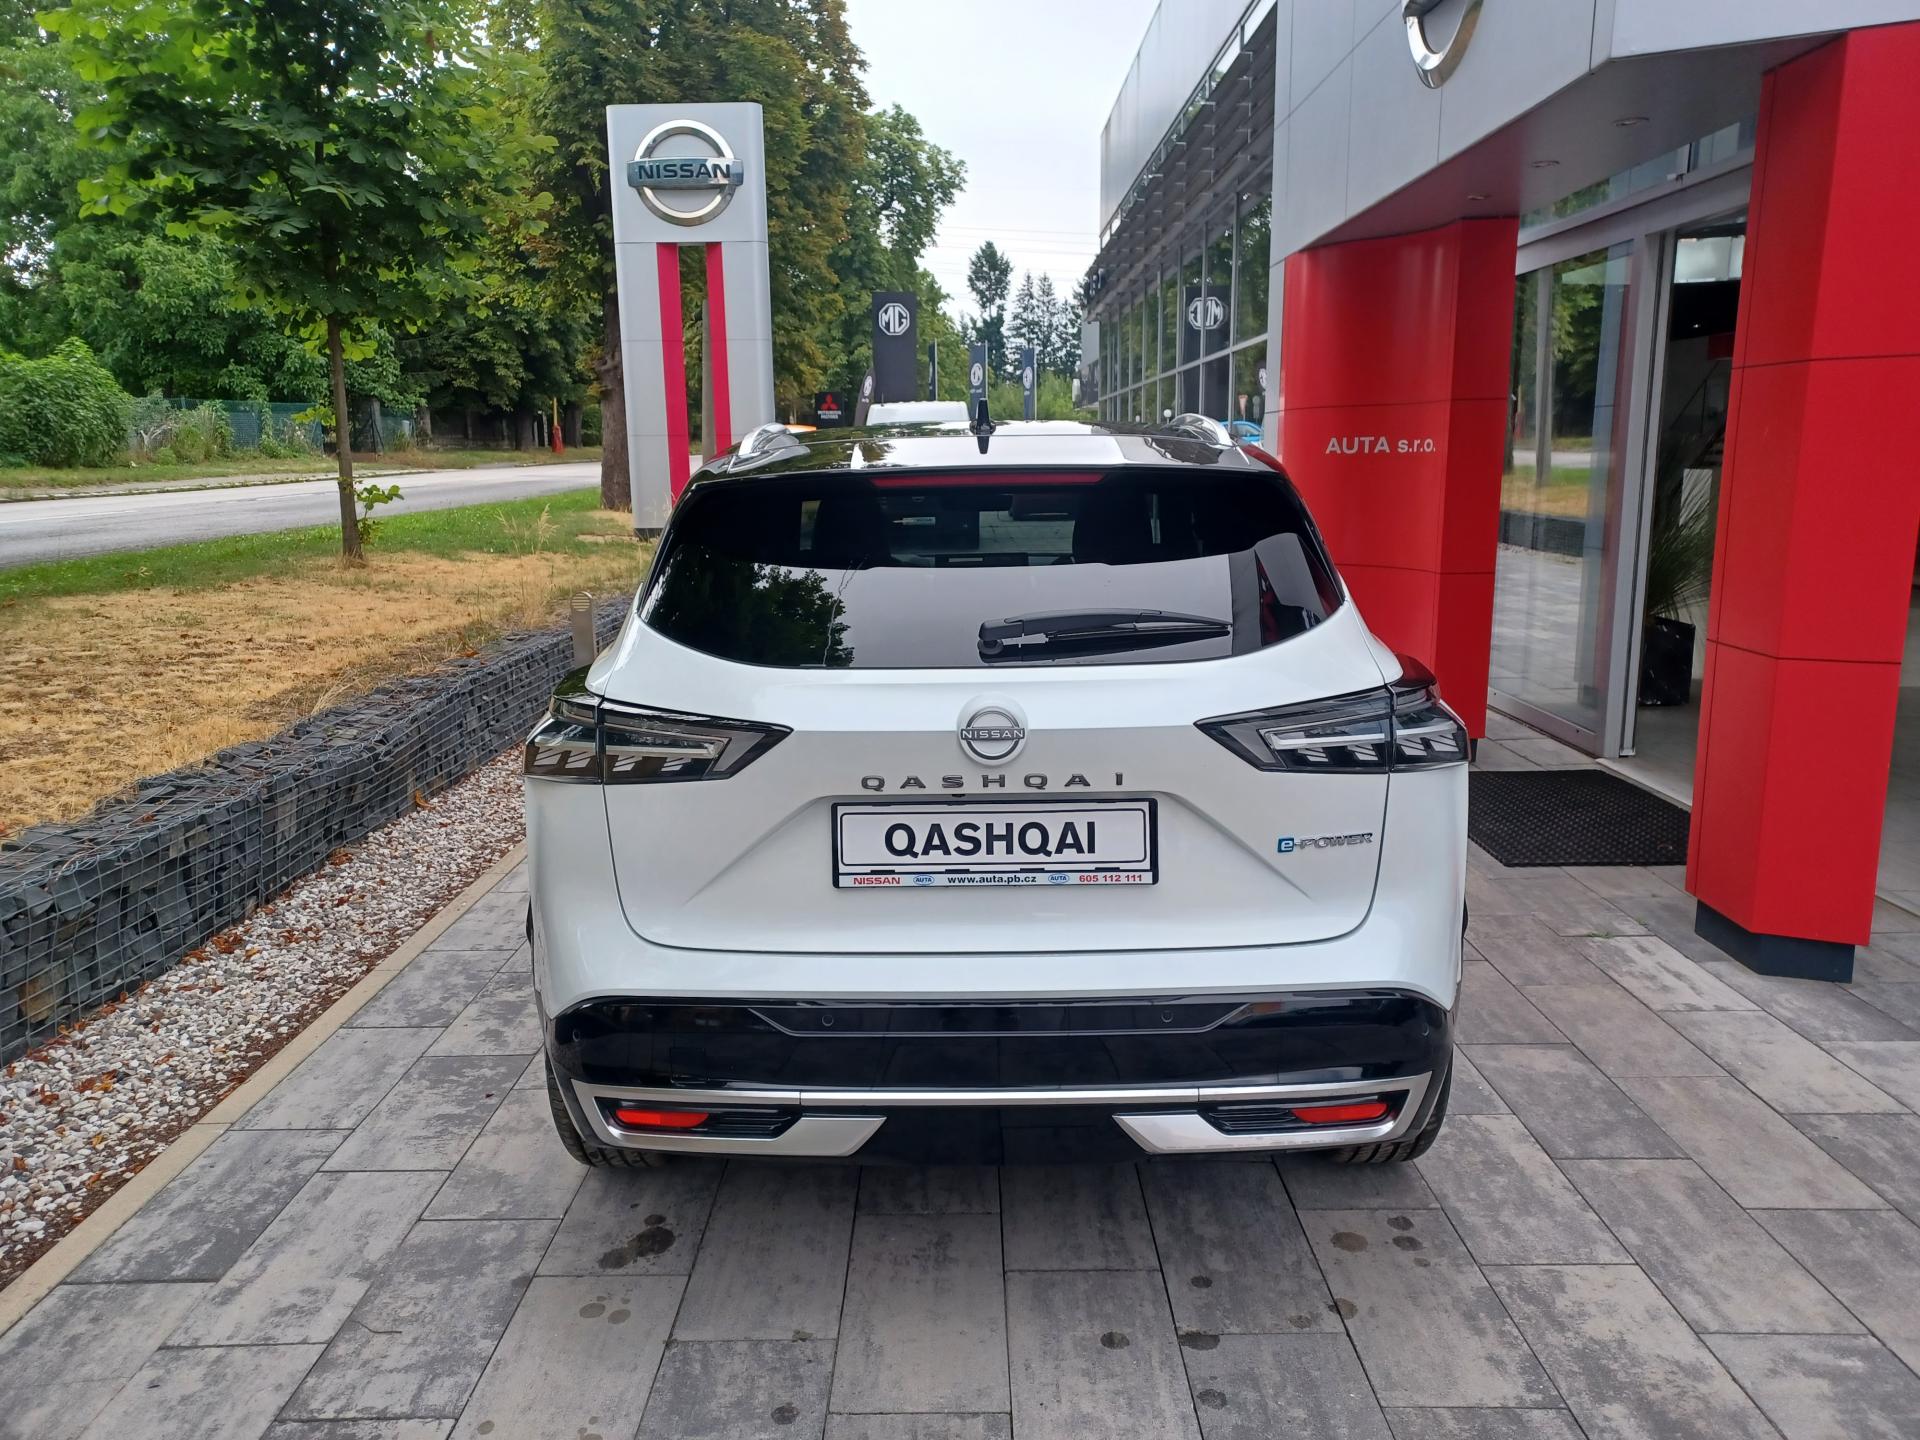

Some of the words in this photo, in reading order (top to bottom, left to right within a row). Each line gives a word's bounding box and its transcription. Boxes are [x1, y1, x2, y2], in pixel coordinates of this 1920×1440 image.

[638, 163, 730, 179] NISSAN
[882, 306, 908, 333] MG
[1326, 436, 1390, 454] AUTA
[1397, 438, 1436, 453] s.r.o.
[962, 729, 1024, 739] NISSAN
[861, 772, 1123, 792] QASHQAI
[884, 821, 1096, 859] QASHQAI
[1278, 832, 1373, 853] e-POWER
[853, 877, 901, 886] NISSAN
[947, 875, 1037, 884] www.auta.pb.cz
[1079, 874, 1099, 883] 605
[1103, 874, 1122, 882] 112
[1125, 874, 1142, 882] 111
